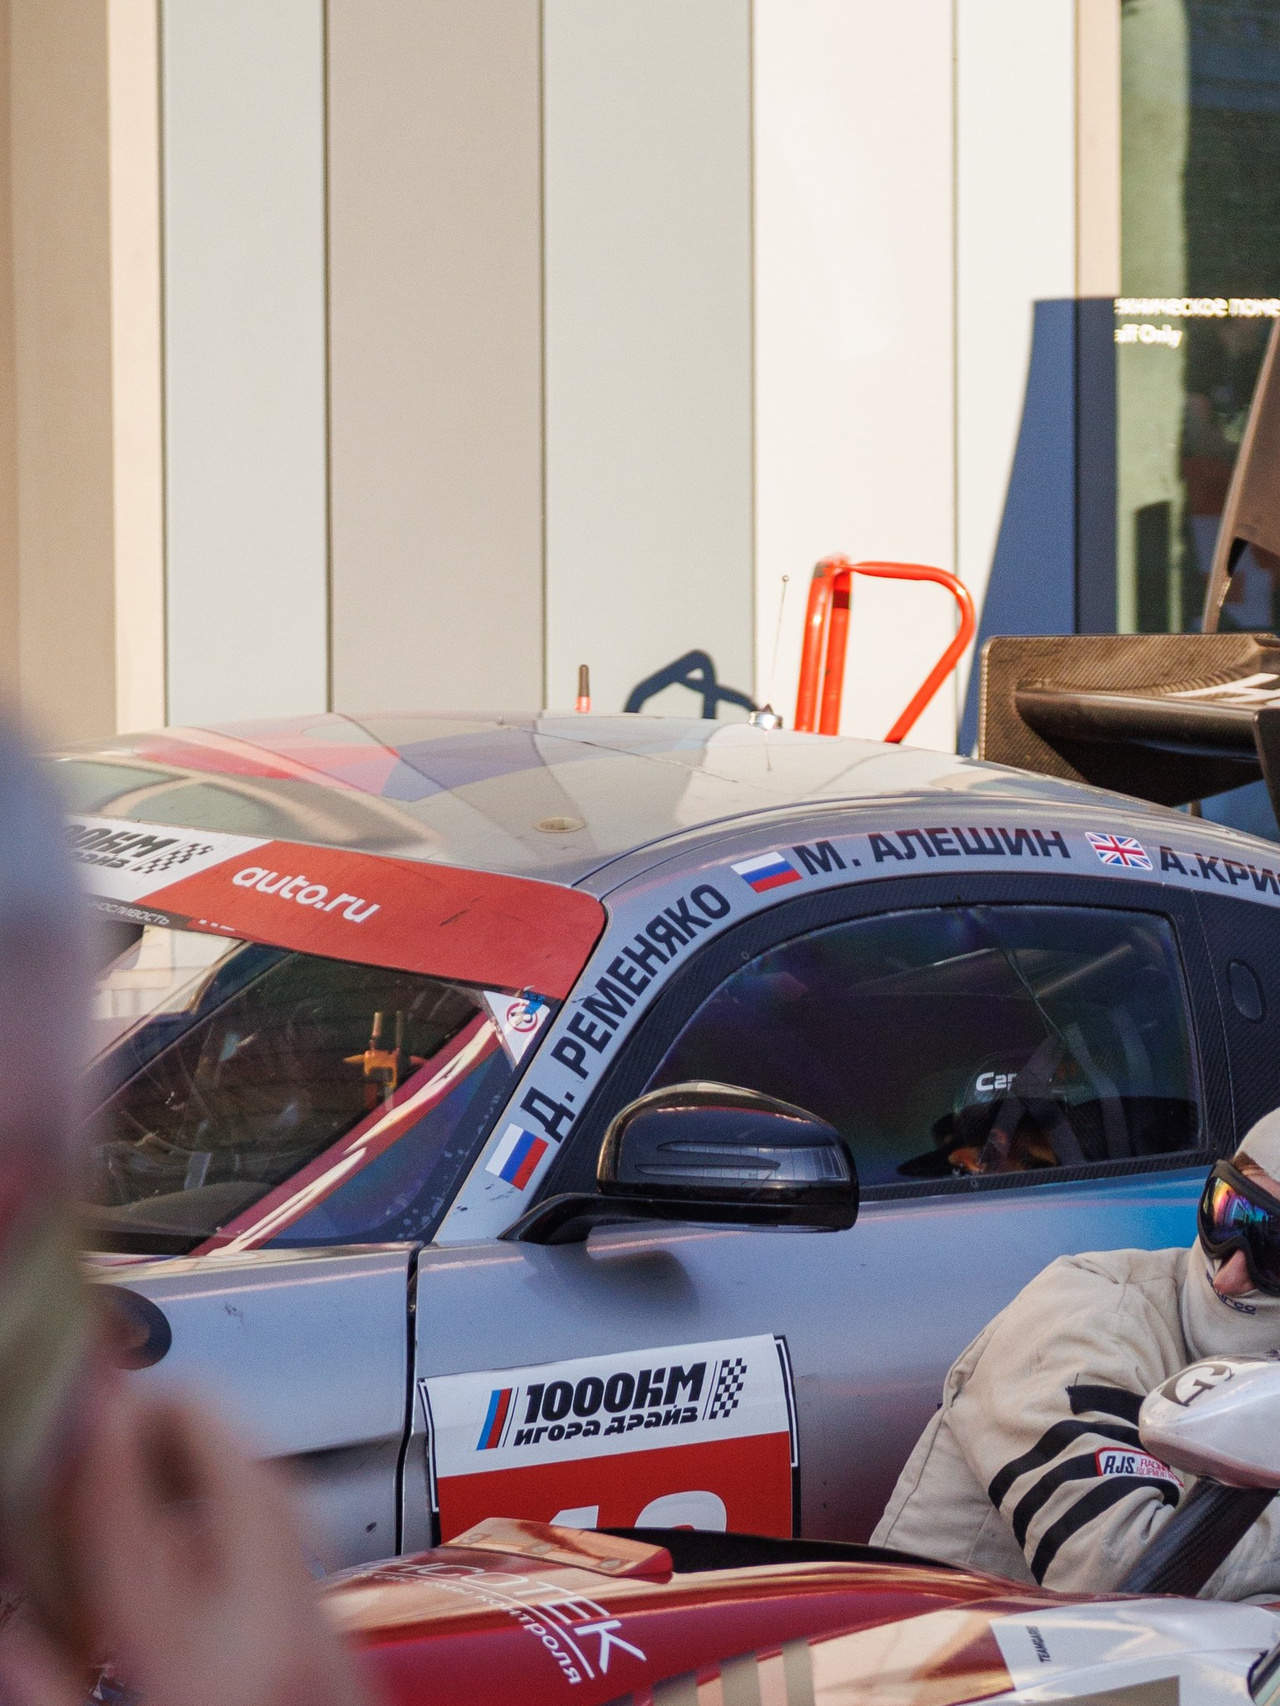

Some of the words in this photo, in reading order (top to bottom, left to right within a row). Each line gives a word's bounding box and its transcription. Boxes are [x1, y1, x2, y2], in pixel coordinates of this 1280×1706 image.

[792, 840, 861, 876] М.
[867, 826, 1071, 863] АЛЕШИН
[232, 866, 381, 923] auto.ru
[520, 1086, 577, 1144] Д.
[550, 883, 731, 1080] РЕМЕНЯКО
[524, 1361, 708, 1426] 1000КМ
